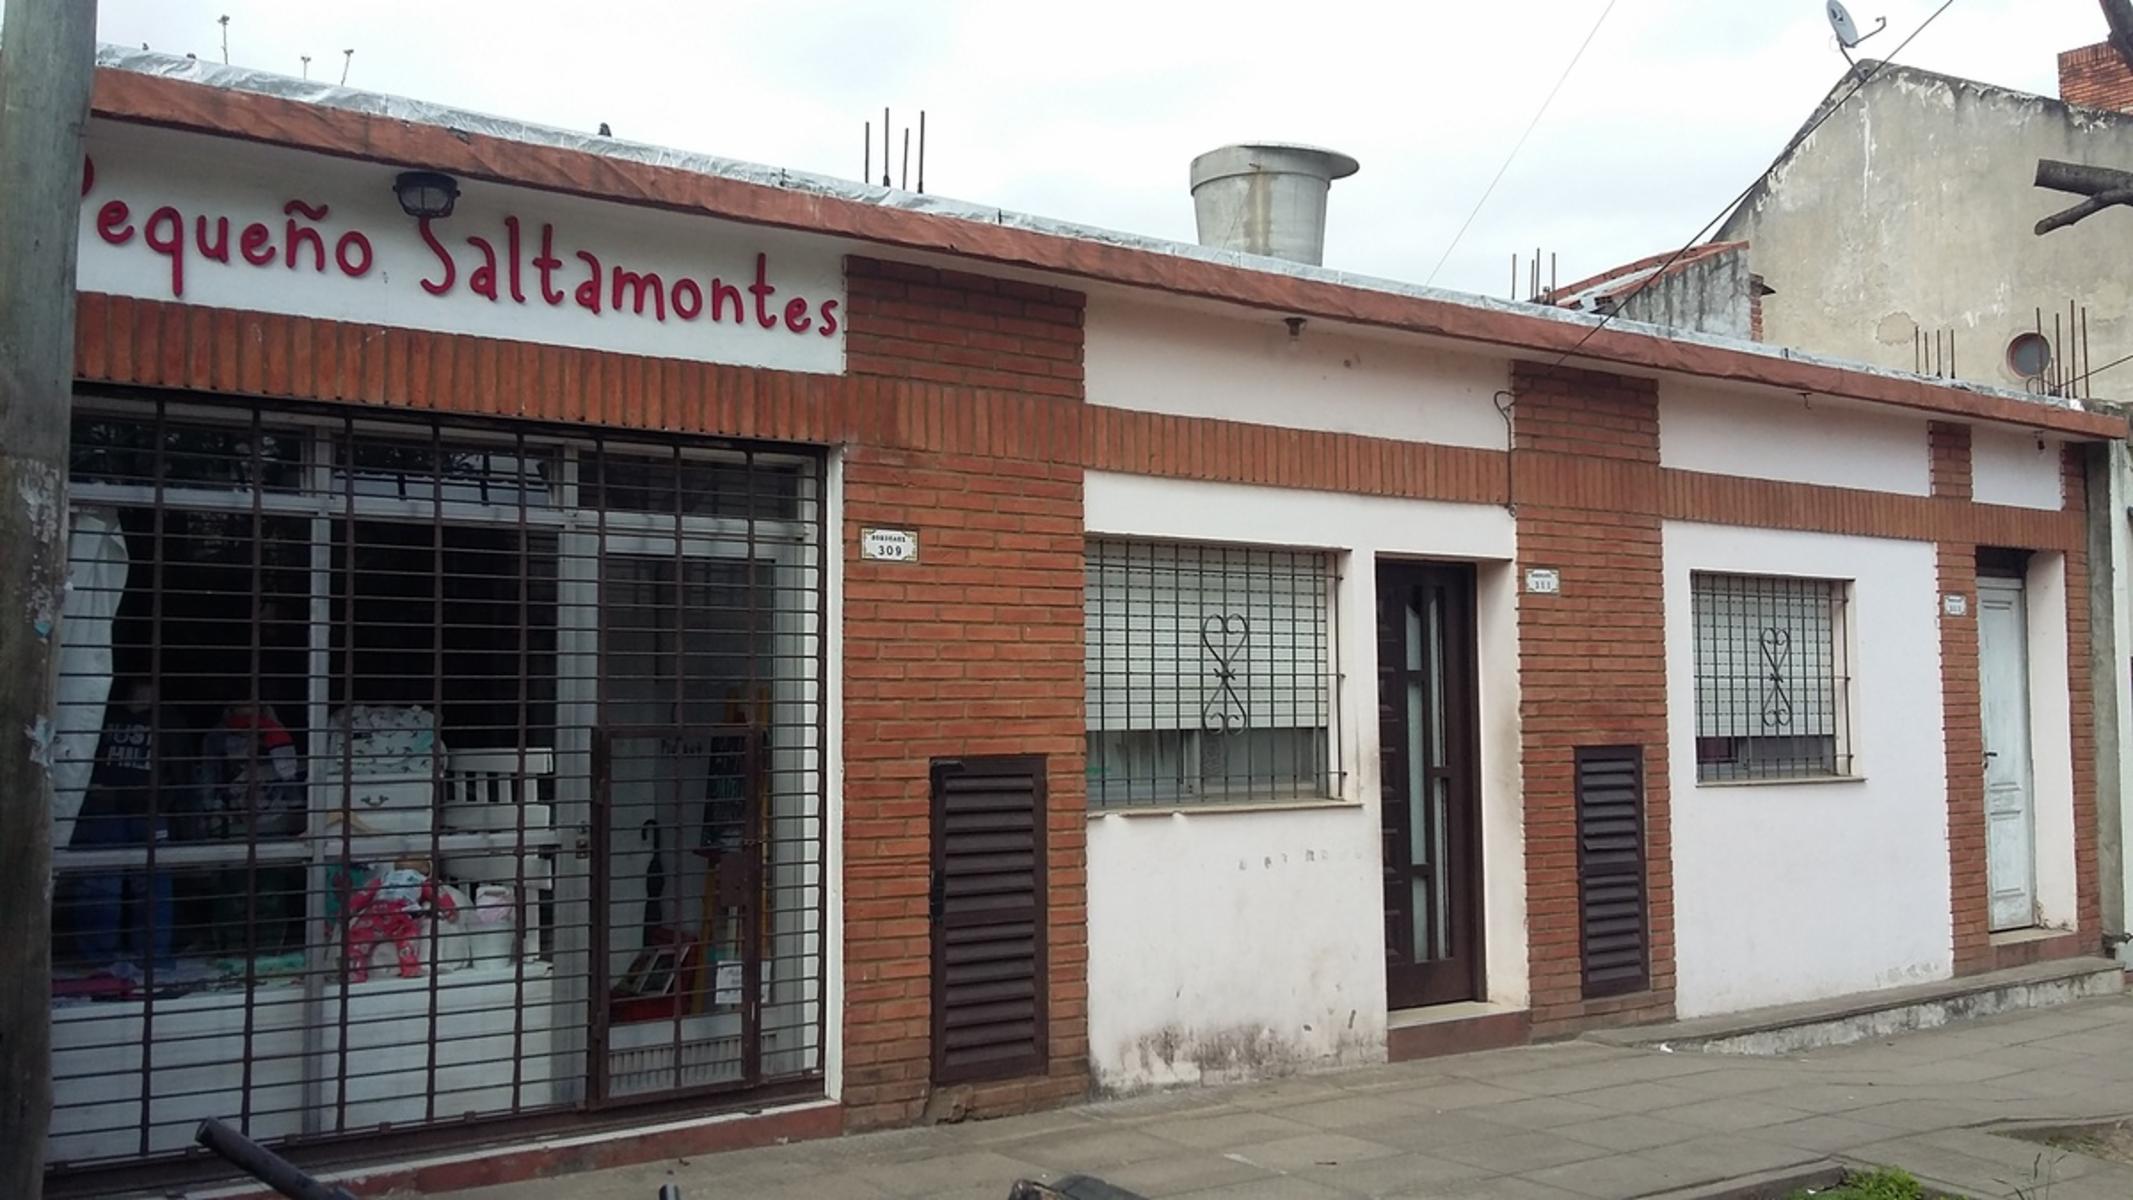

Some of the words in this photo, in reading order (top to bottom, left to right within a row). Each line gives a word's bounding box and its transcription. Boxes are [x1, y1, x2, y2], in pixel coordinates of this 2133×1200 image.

[81, 152, 373, 297] equeño
[419, 214, 840, 337] Saltamontes
[878, 545, 902, 556] 309
